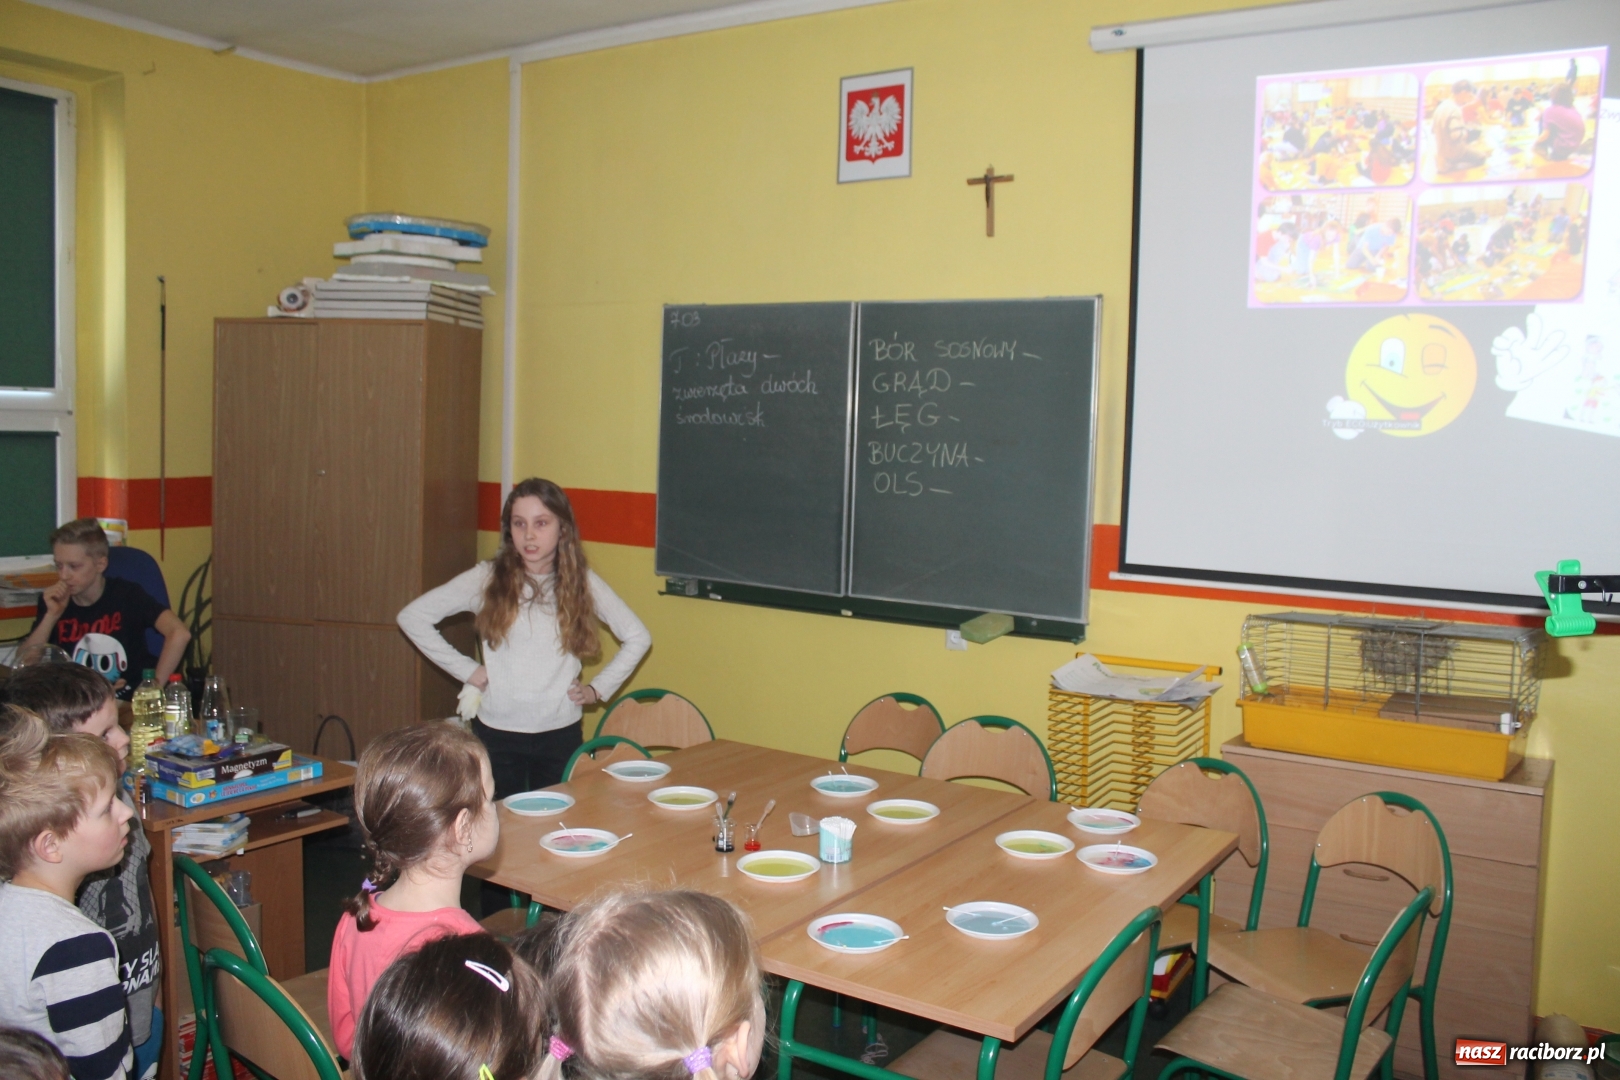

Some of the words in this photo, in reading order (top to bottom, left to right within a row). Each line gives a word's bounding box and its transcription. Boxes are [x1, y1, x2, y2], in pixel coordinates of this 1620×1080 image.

[869, 331, 917, 362] BÓR
[935, 336, 1017, 361] SOSNOWY
[761, 369, 818, 395] dwóch
[872, 368, 951, 398] GRĄD
[871, 402, 941, 434] ŁĘG
[868, 441, 969, 468] BUCZYNA
[874, 471, 924, 497] OLS
[221, 757, 268, 775] Magnetyzm
